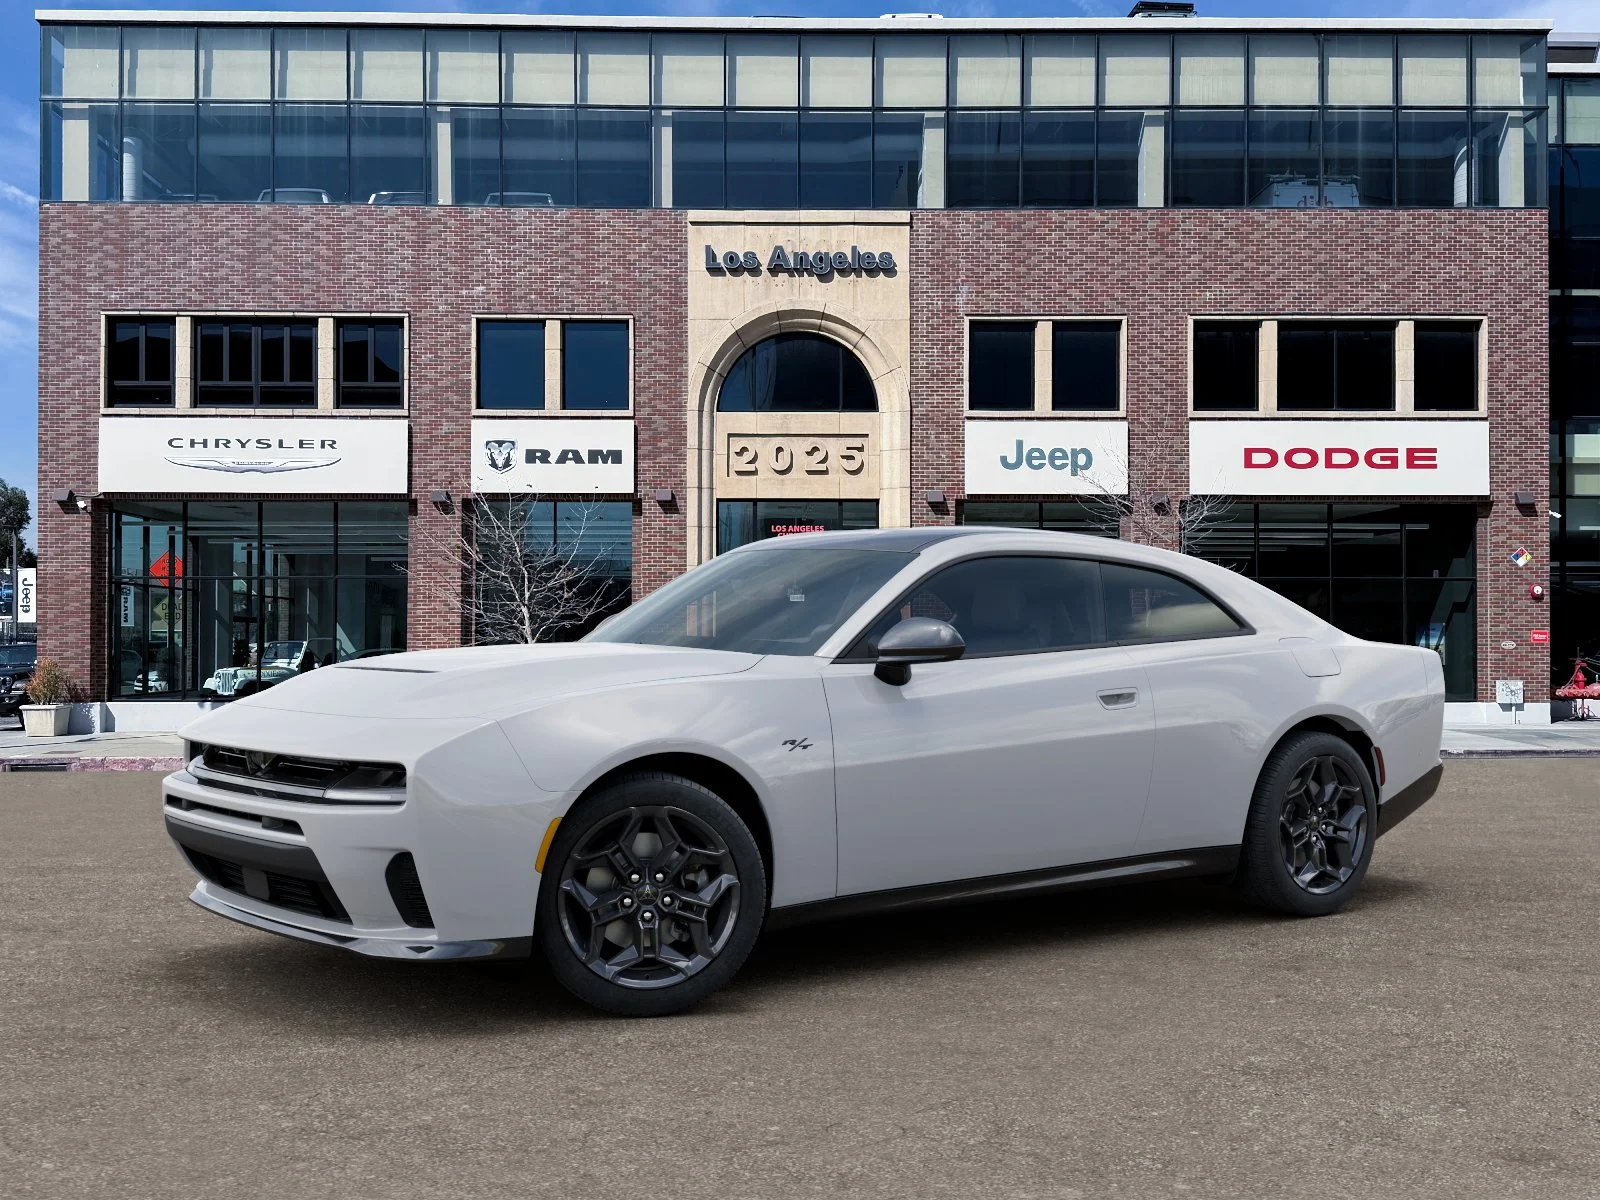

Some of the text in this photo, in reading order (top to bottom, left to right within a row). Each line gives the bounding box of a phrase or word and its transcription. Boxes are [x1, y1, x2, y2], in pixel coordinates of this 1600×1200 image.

[704, 244, 895, 275] Los Angeles
[167, 437, 338, 450] CHRYSLER
[524, 448, 623, 465] RAM
[733, 440, 865, 476] 2025
[999, 438, 1094, 477] Jeep
[1243, 447, 1438, 470] DODGE
[771, 524, 825, 534] LOS ANGELES
[20, 577, 34, 614] Jeep
[164, 612, 182, 620] ED
